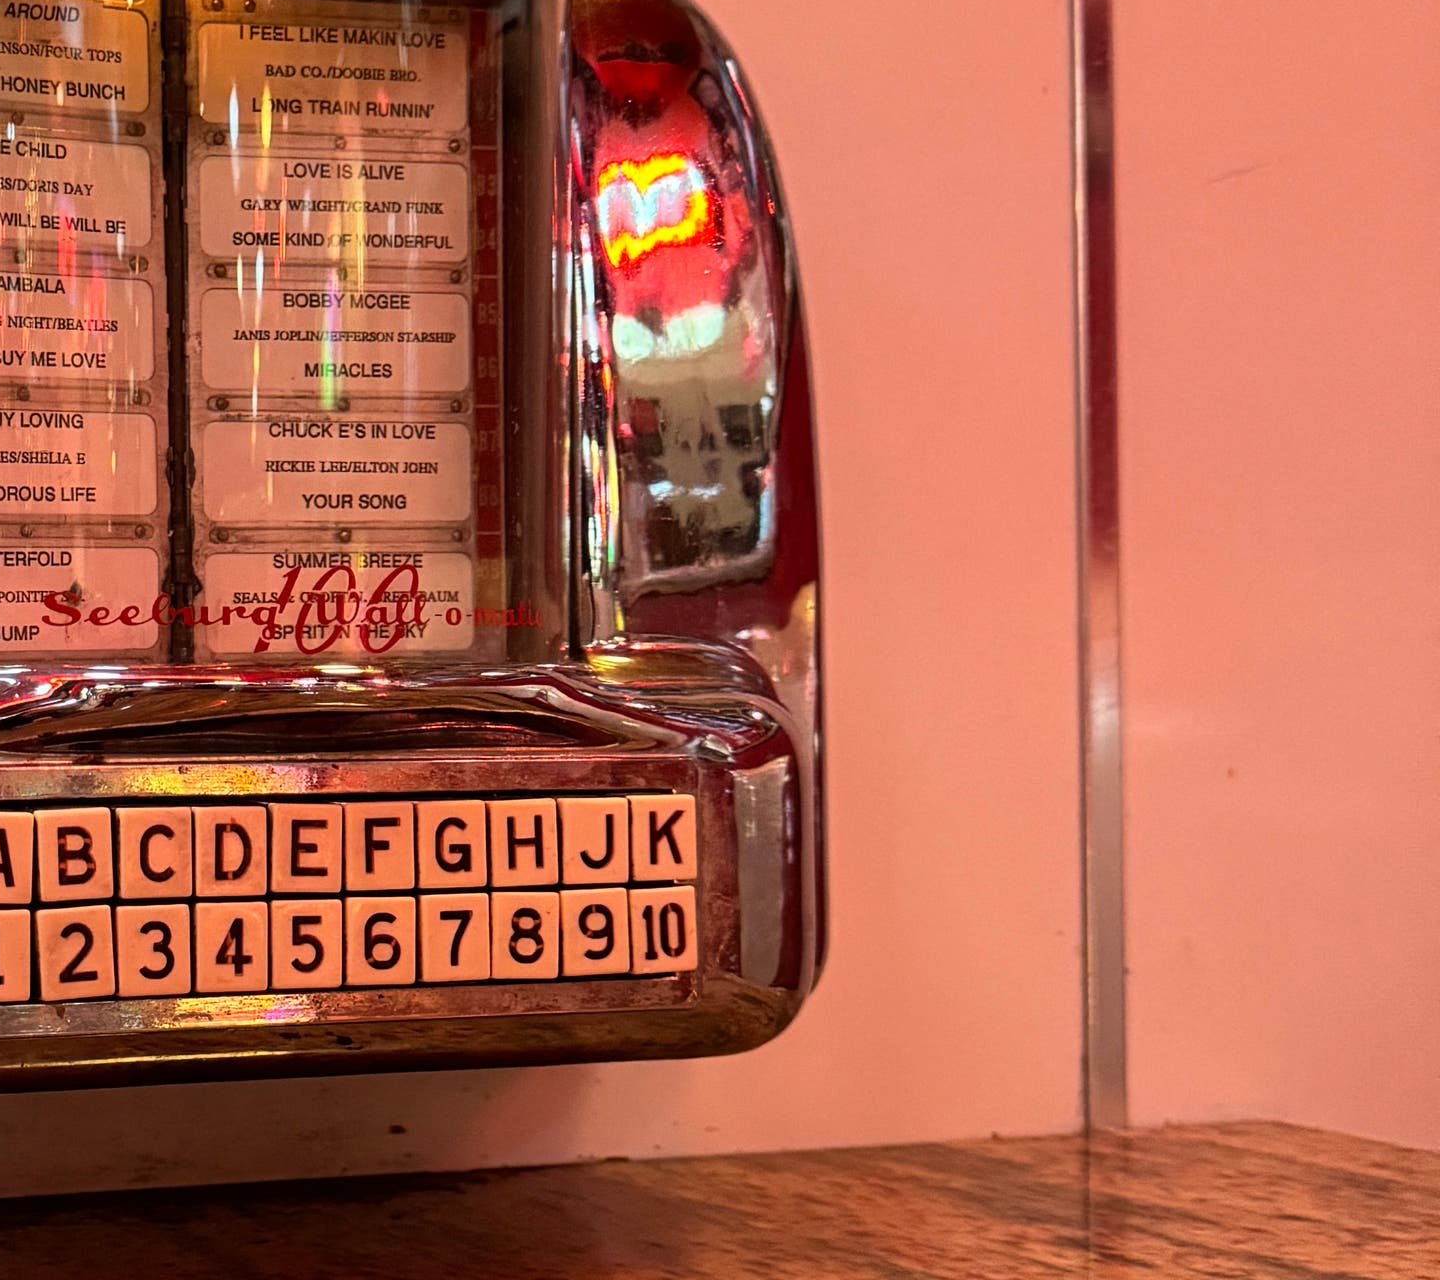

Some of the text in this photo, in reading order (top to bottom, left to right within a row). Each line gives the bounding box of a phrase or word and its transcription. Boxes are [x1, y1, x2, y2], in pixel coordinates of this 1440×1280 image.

[4, 2, 80, 23] AROUND
[239, 24, 445, 49] I FEEL LIKE MAKIN LOVE
[87, 49, 122, 63] TOPS
[265, 64, 421, 82] BAD CO./DOOBIE BRO.
[1, 75, 59, 96] HONEY
[66, 82, 125, 101] BUNCH
[307, 99, 360, 115] TRAIN
[366, 102, 435, 118] RUNNIN'
[15, 141, 67, 159] CHILD
[284, 163, 404, 180] LOVE IS ALIVE
[64, 183, 94, 196] DAY
[241, 199, 444, 215] GARY WRIGHT/GRAND FUNK
[41, 215, 60, 230] BE
[65, 216, 100, 233] WILL
[105, 218, 126, 235] BE
[232, 231, 280, 246] SOME
[285, 232, 325, 246] KIND
[283, 293, 410, 310] BOBBY MCGEE
[7, 315, 119, 332] NIGHT/BEATLES
[233, 329, 456, 343] JANIS JOPLIN/JEFFERSON STARSHIP
[31, 351, 57, 367] ME
[62, 353, 106, 369] LOVE
[305, 362, 393, 378] MIRACLES
[20, 412, 84, 430] LOVING
[268, 422, 436, 440] CHUCK E'S IN LOVE
[77, 452, 86, 465] E
[265, 460, 438, 475] RICKIE LEE/ELTON JOHN
[60, 486, 96, 502] LIFE
[302, 494, 407, 510] YOUR SONG
[273, 553, 423, 569] SUMMER BREEZE
[233, 592, 279, 604] SEALS
[41, 590, 278, 641] Seeburg
[272, 623, 329, 640] SPRIT
[57, 824, 97, 886] B
[139, 823, 176, 884] C
[214, 821, 252, 882] D
[290, 819, 329, 878] E
[365, 817, 401, 875] F
[435, 815, 472, 873] G
[506, 814, 545, 869] H
[579, 813, 614, 869] J
[648, 809, 685, 866] K
[59, 922, 99, 984] 2
[139, 920, 173, 981] 3
[214, 917, 253, 977] 4
[290, 915, 324, 975] 5
[363, 912, 402, 971] 6
[439, 909, 473, 967] 7
[509, 907, 545, 965] 8
[577, 903, 615, 960] 9
[642, 901, 686, 960] 10
